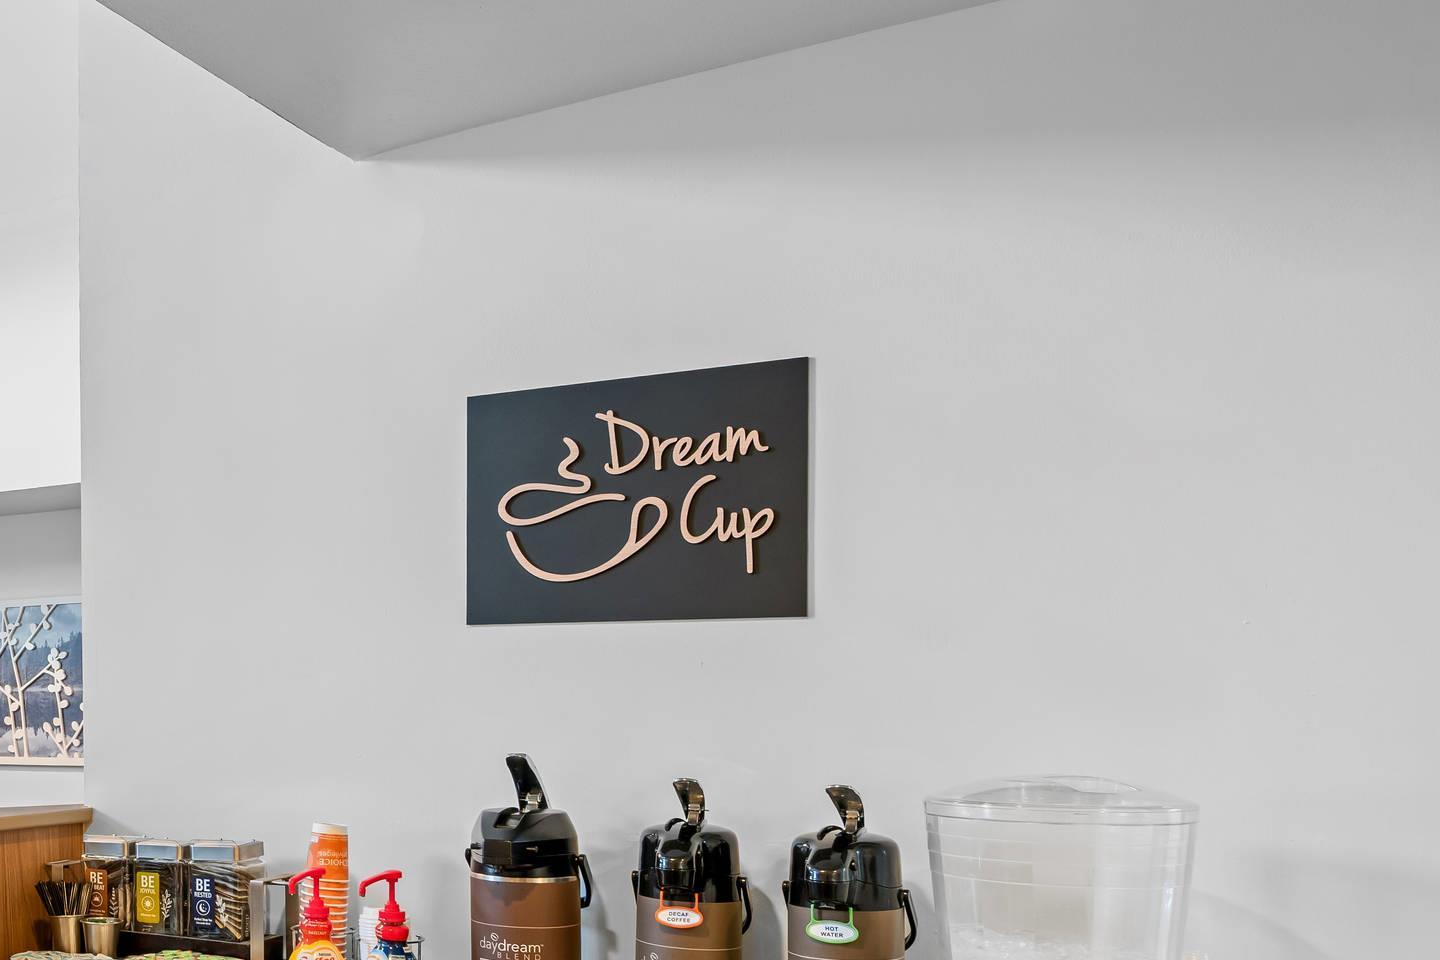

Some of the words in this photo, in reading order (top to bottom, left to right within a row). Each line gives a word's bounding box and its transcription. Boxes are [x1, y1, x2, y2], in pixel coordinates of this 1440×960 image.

[595, 410, 769, 475] Dream
[680, 474, 775, 574] Cup
[89, 871, 104, 885] BE
[140, 874, 155, 888] BE
[195, 878, 211, 892] BE
[193, 891, 213, 899] RESTED
[479, 935, 541, 955] daydream
